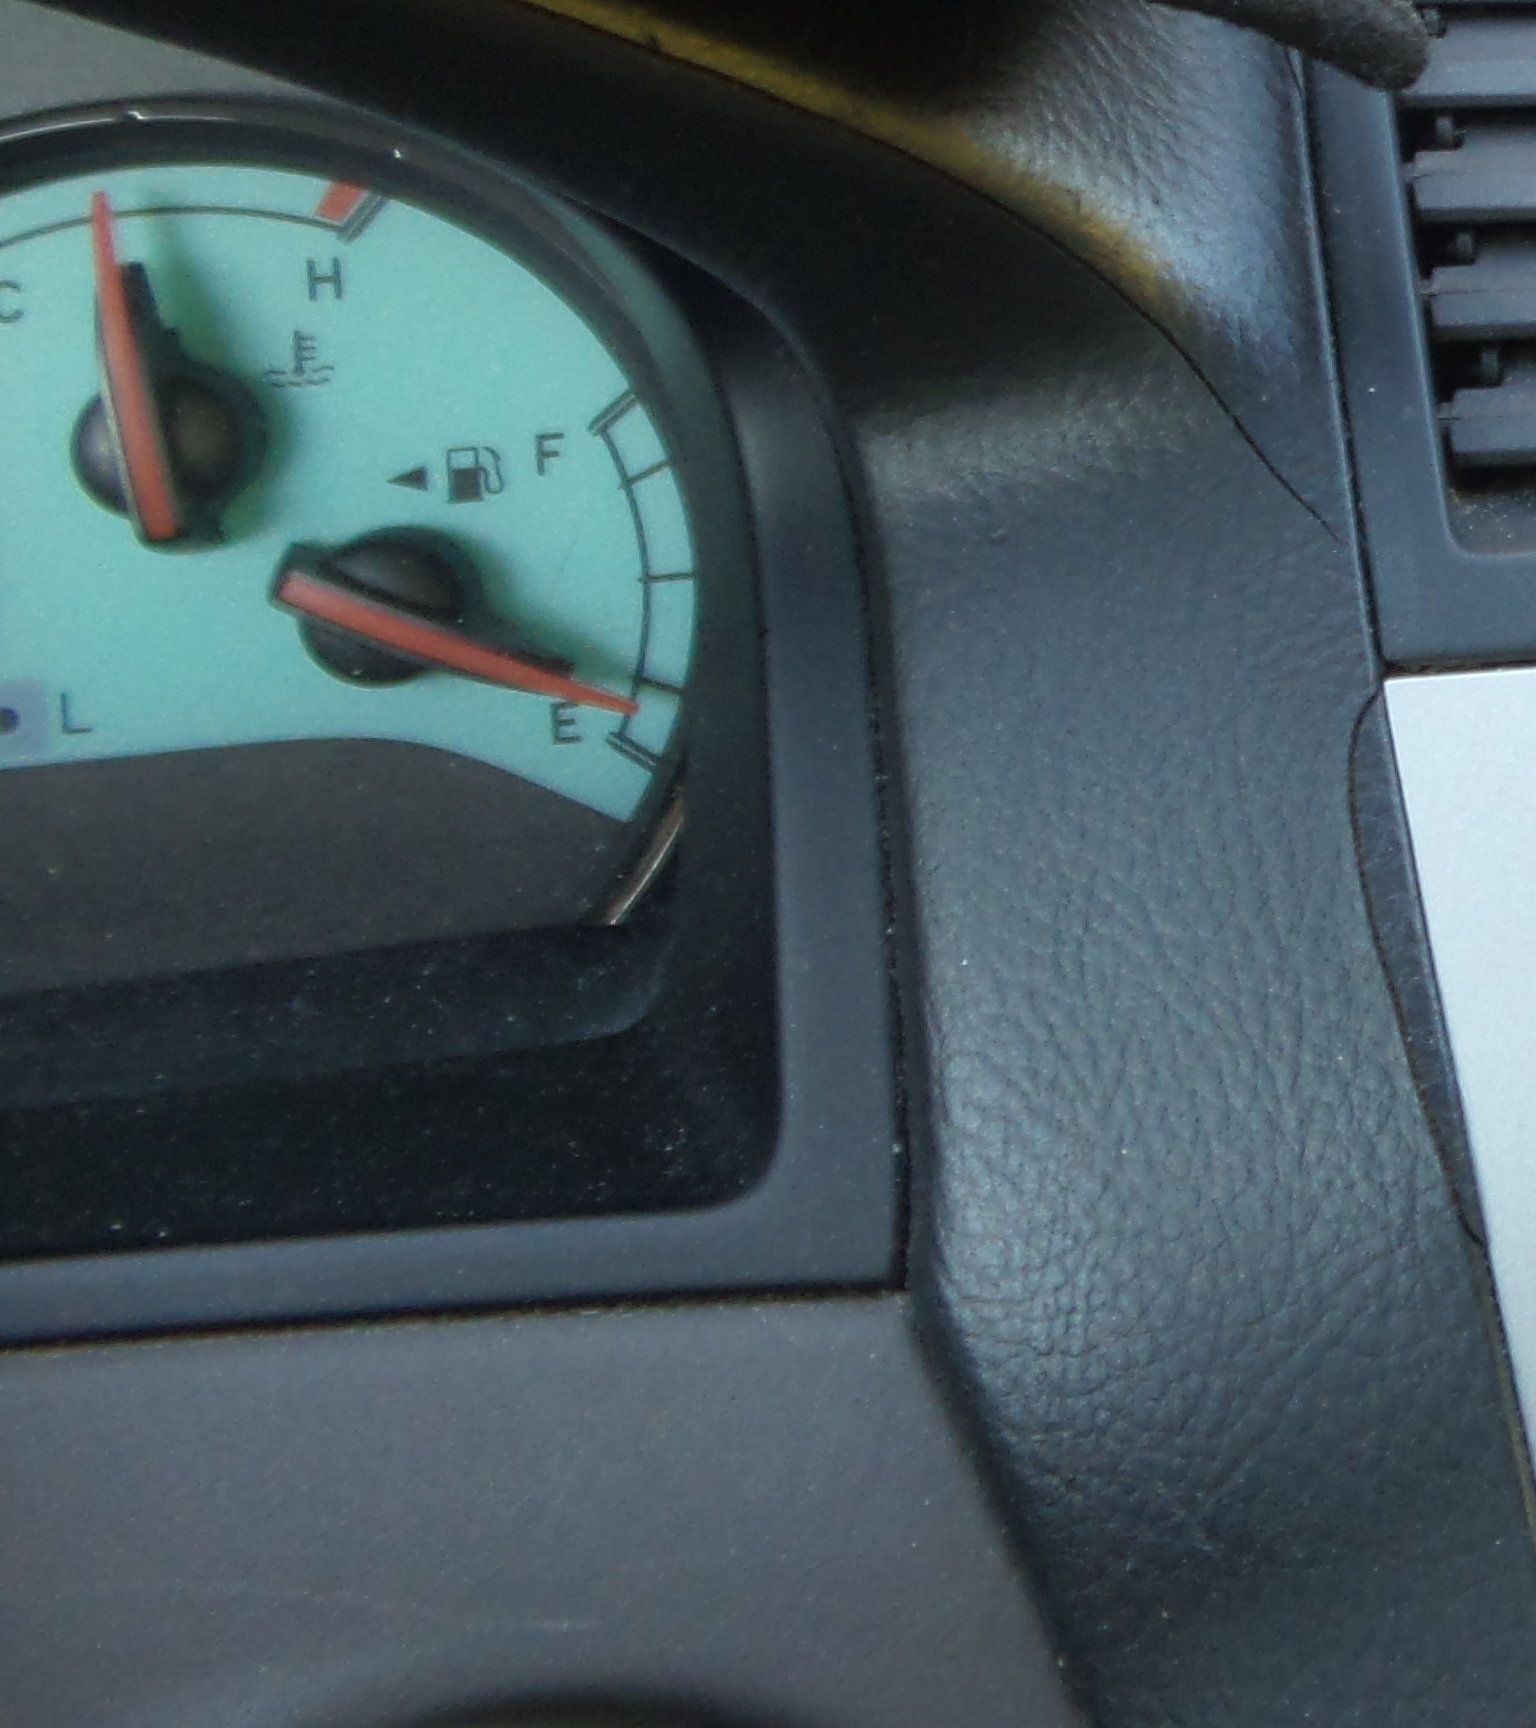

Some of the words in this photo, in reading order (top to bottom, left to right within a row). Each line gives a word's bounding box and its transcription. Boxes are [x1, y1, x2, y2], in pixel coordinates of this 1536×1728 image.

[306, 257, 344, 301] H
[535, 432, 566, 477] F
[60, 691, 93, 735] L
[549, 702, 583, 746] E
